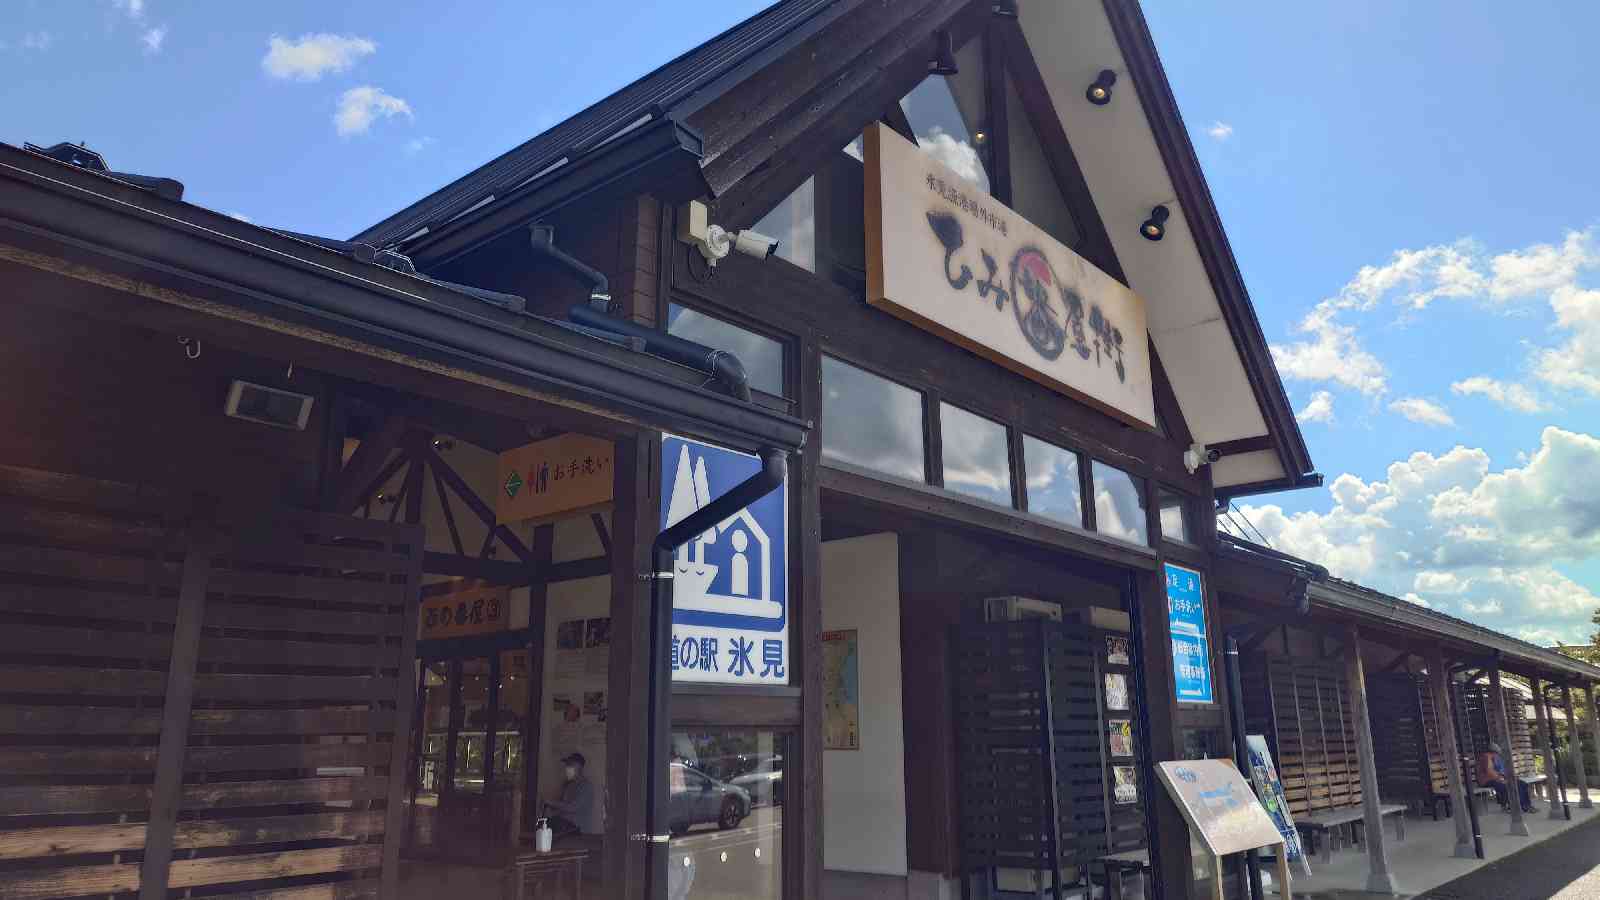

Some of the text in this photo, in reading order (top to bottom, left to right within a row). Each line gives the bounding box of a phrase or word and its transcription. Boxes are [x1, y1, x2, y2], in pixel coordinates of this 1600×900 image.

[553, 455, 609, 481] お手洗い
[727, 636, 785, 678] 氷見
